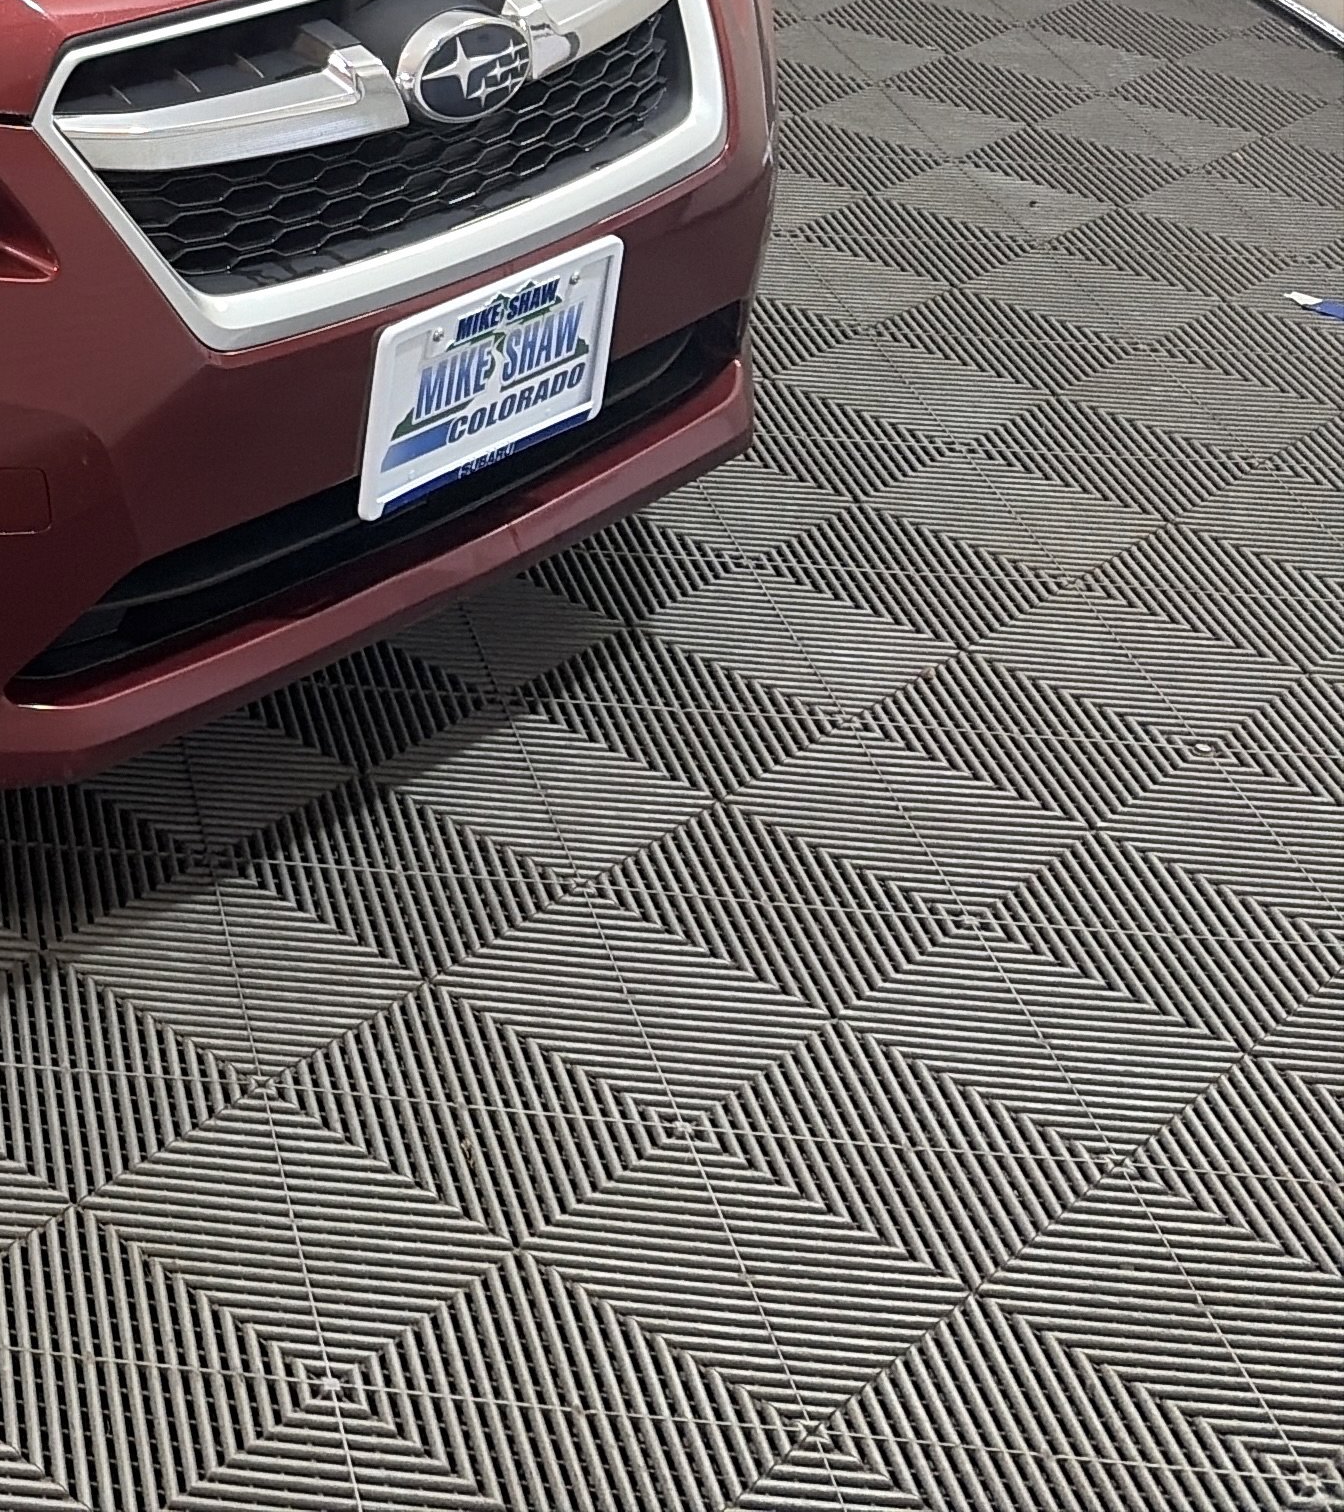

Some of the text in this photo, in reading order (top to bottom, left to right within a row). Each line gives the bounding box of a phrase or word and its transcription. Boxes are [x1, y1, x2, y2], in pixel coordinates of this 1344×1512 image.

[456, 279, 560, 342] MIKE SHAW
[416, 302, 583, 419] MIKE SHAW
[448, 362, 586, 444] COLORADO
